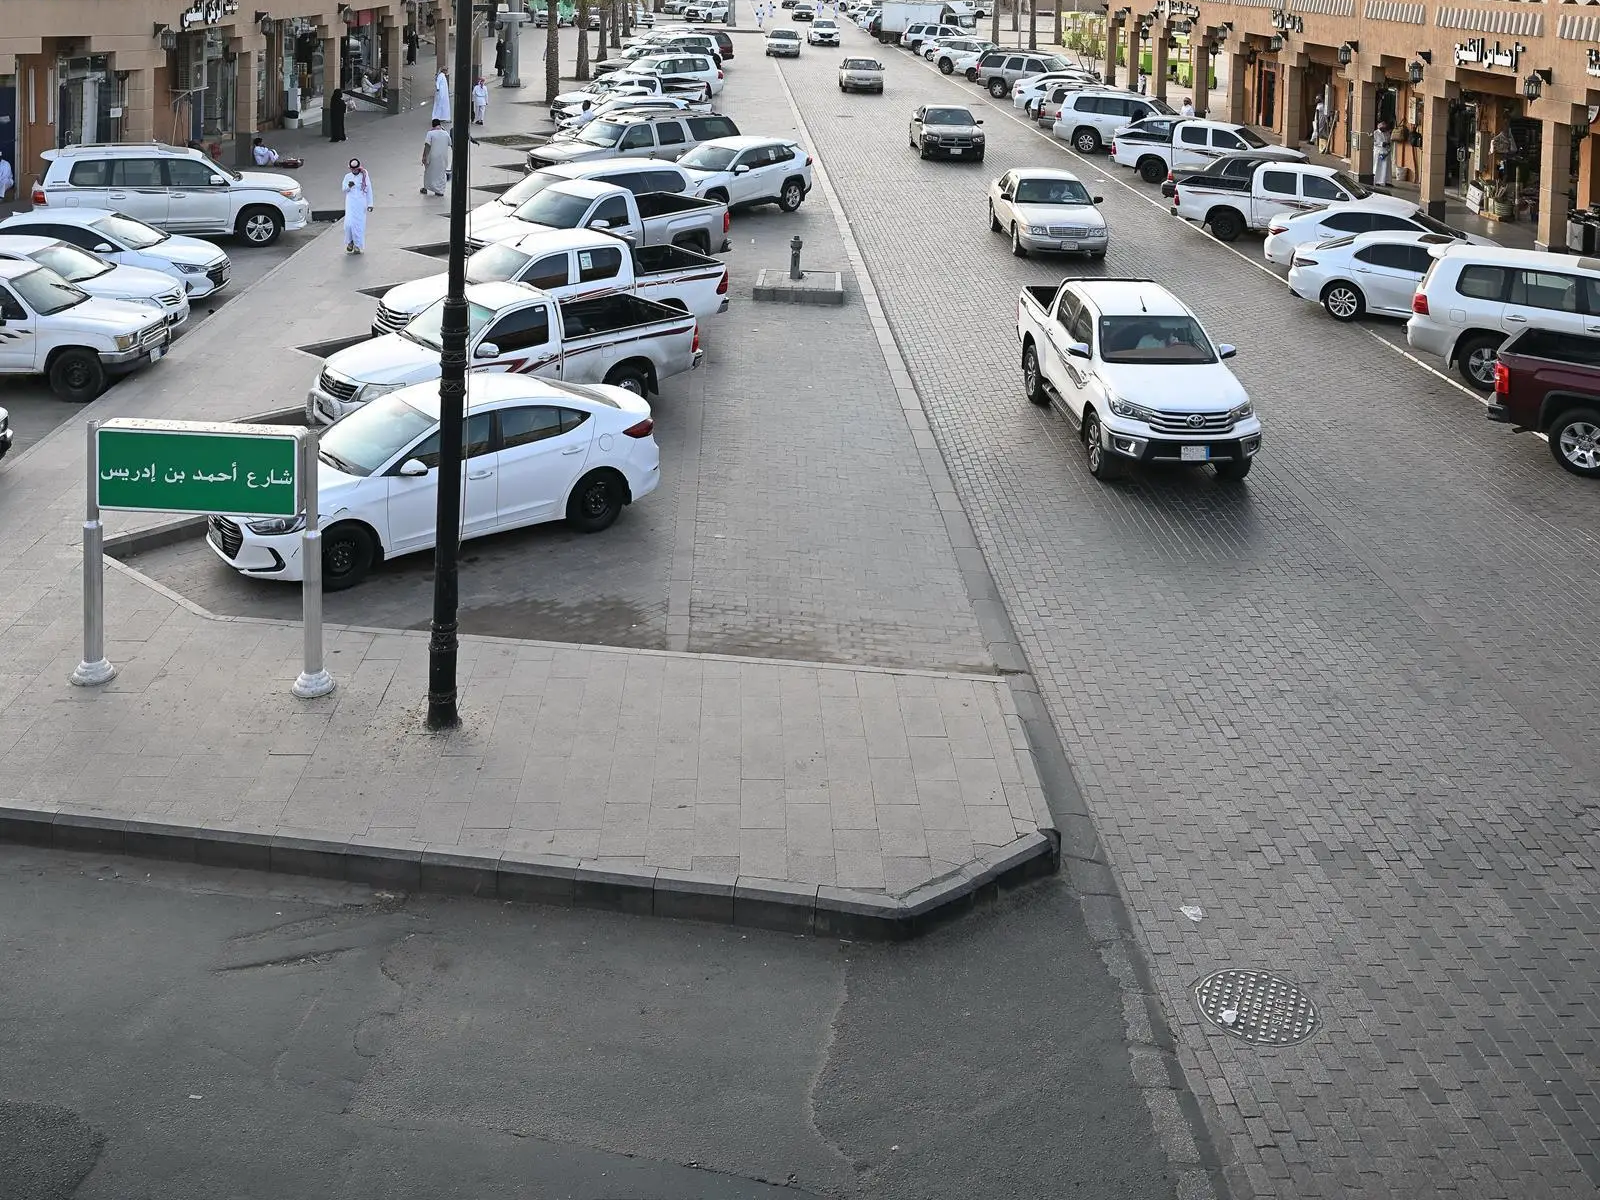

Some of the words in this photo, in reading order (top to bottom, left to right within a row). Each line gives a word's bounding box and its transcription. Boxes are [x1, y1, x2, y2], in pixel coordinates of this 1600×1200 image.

[100, 462, 156, 483] إدريس
[164, 466, 185, 484] بن
[192, 461, 237, 483] أحمد
[246, 469, 293, 488] شارع
[1272, 998, 1287, 1026] SEWER
